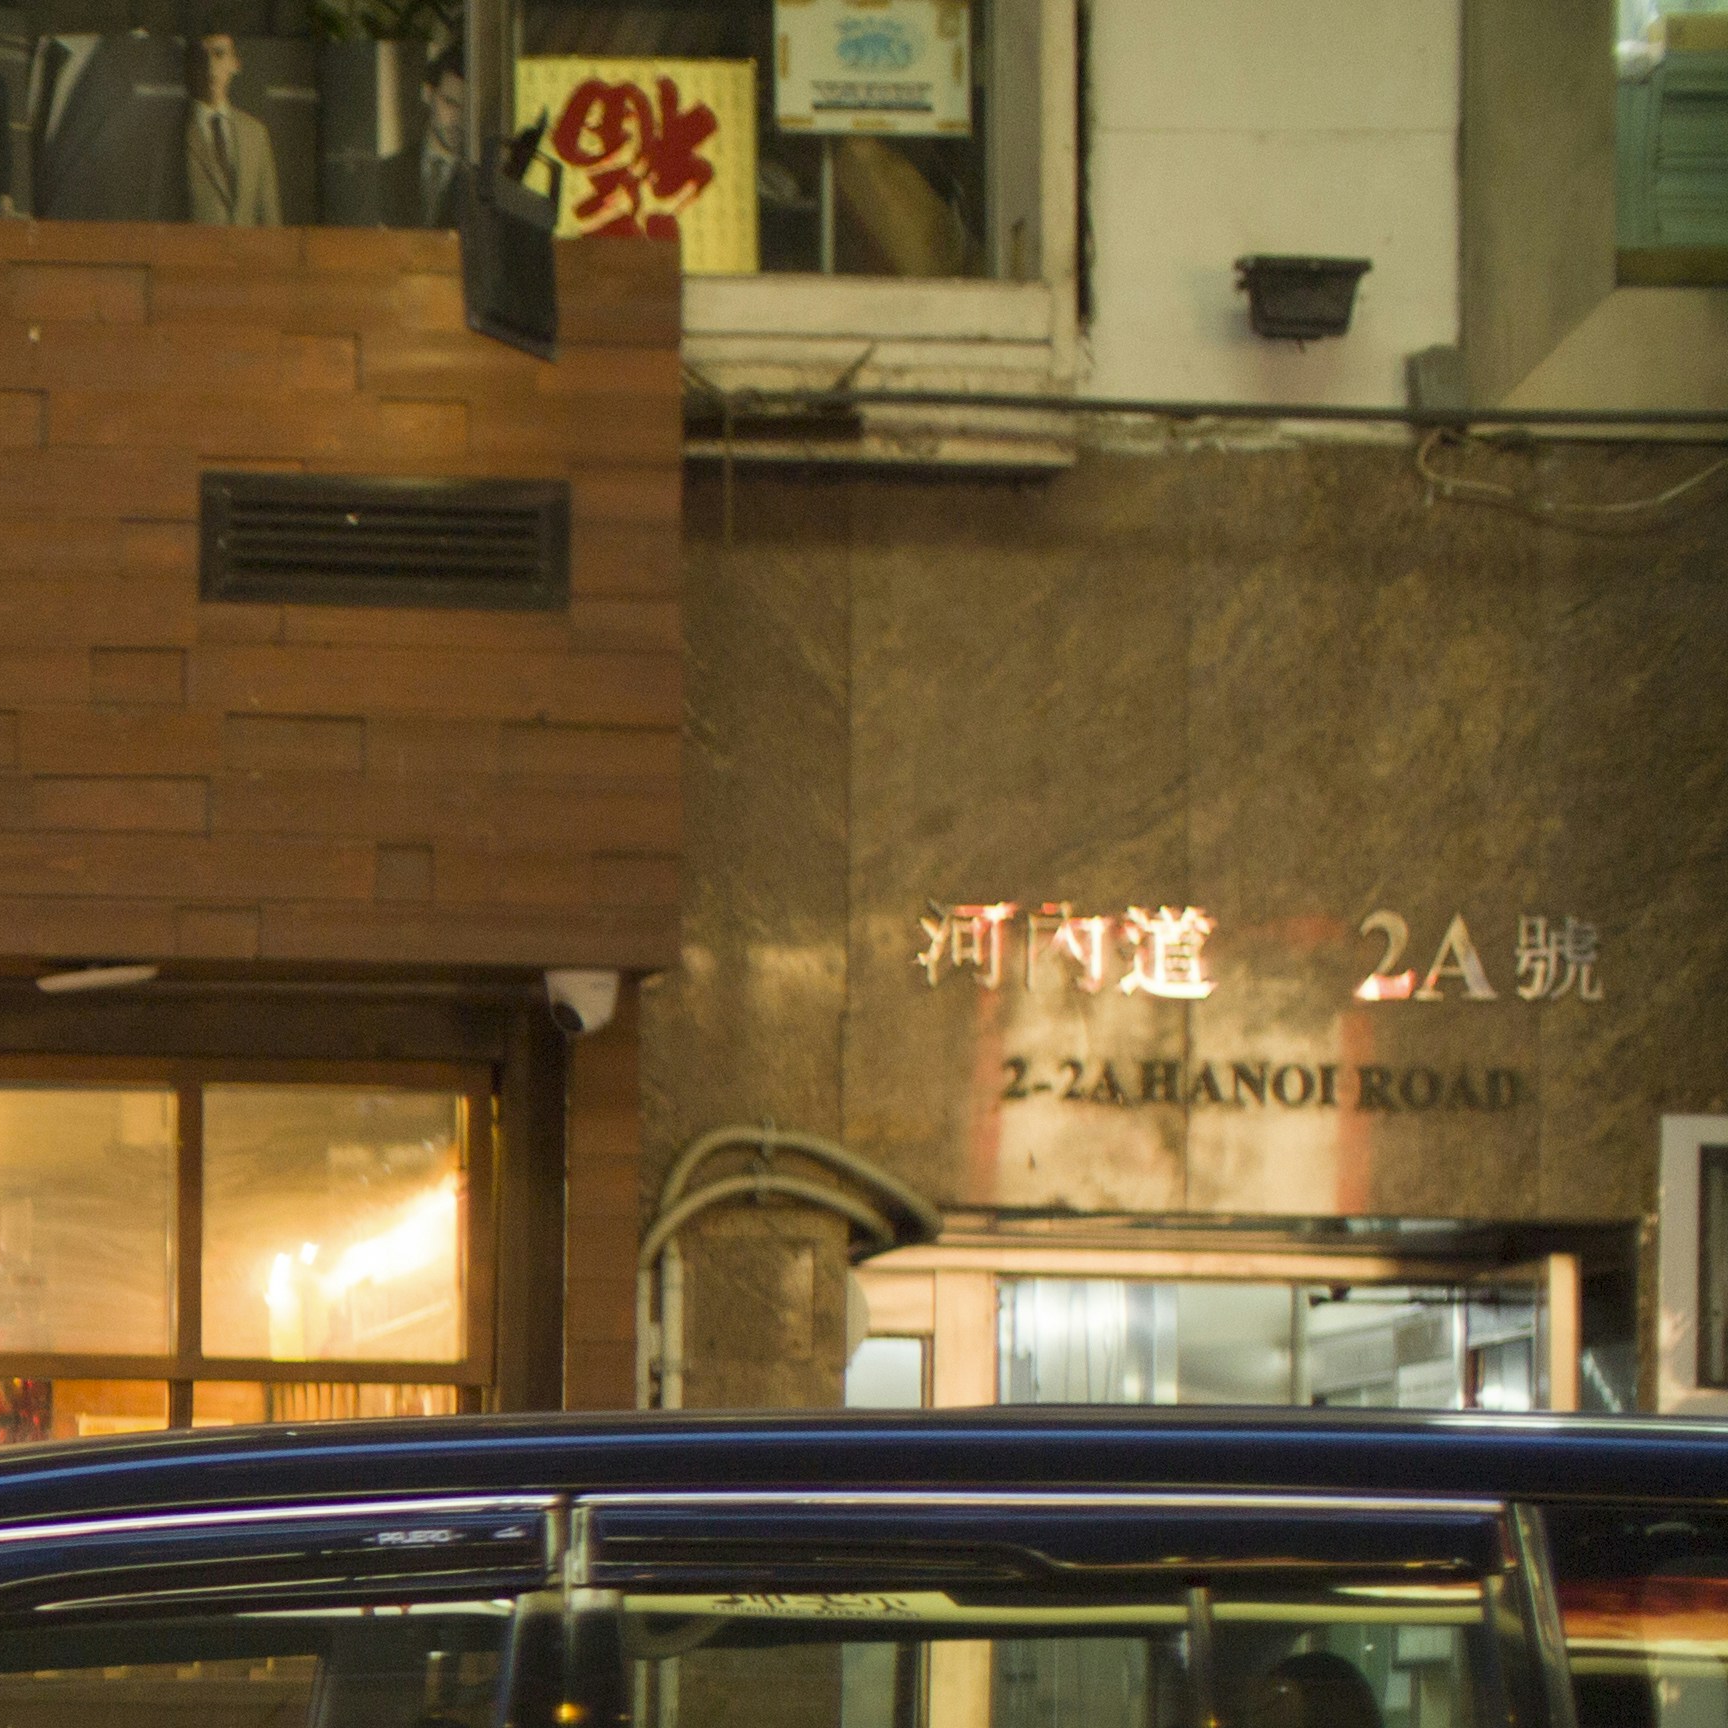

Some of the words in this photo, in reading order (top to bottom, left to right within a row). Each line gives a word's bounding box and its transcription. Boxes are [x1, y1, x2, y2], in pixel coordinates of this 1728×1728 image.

[1001, 1056, 1132, 1107] 2-2A
[1141, 1058, 1340, 1111] HANOI
[1354, 1063, 1529, 1114] ROAD
